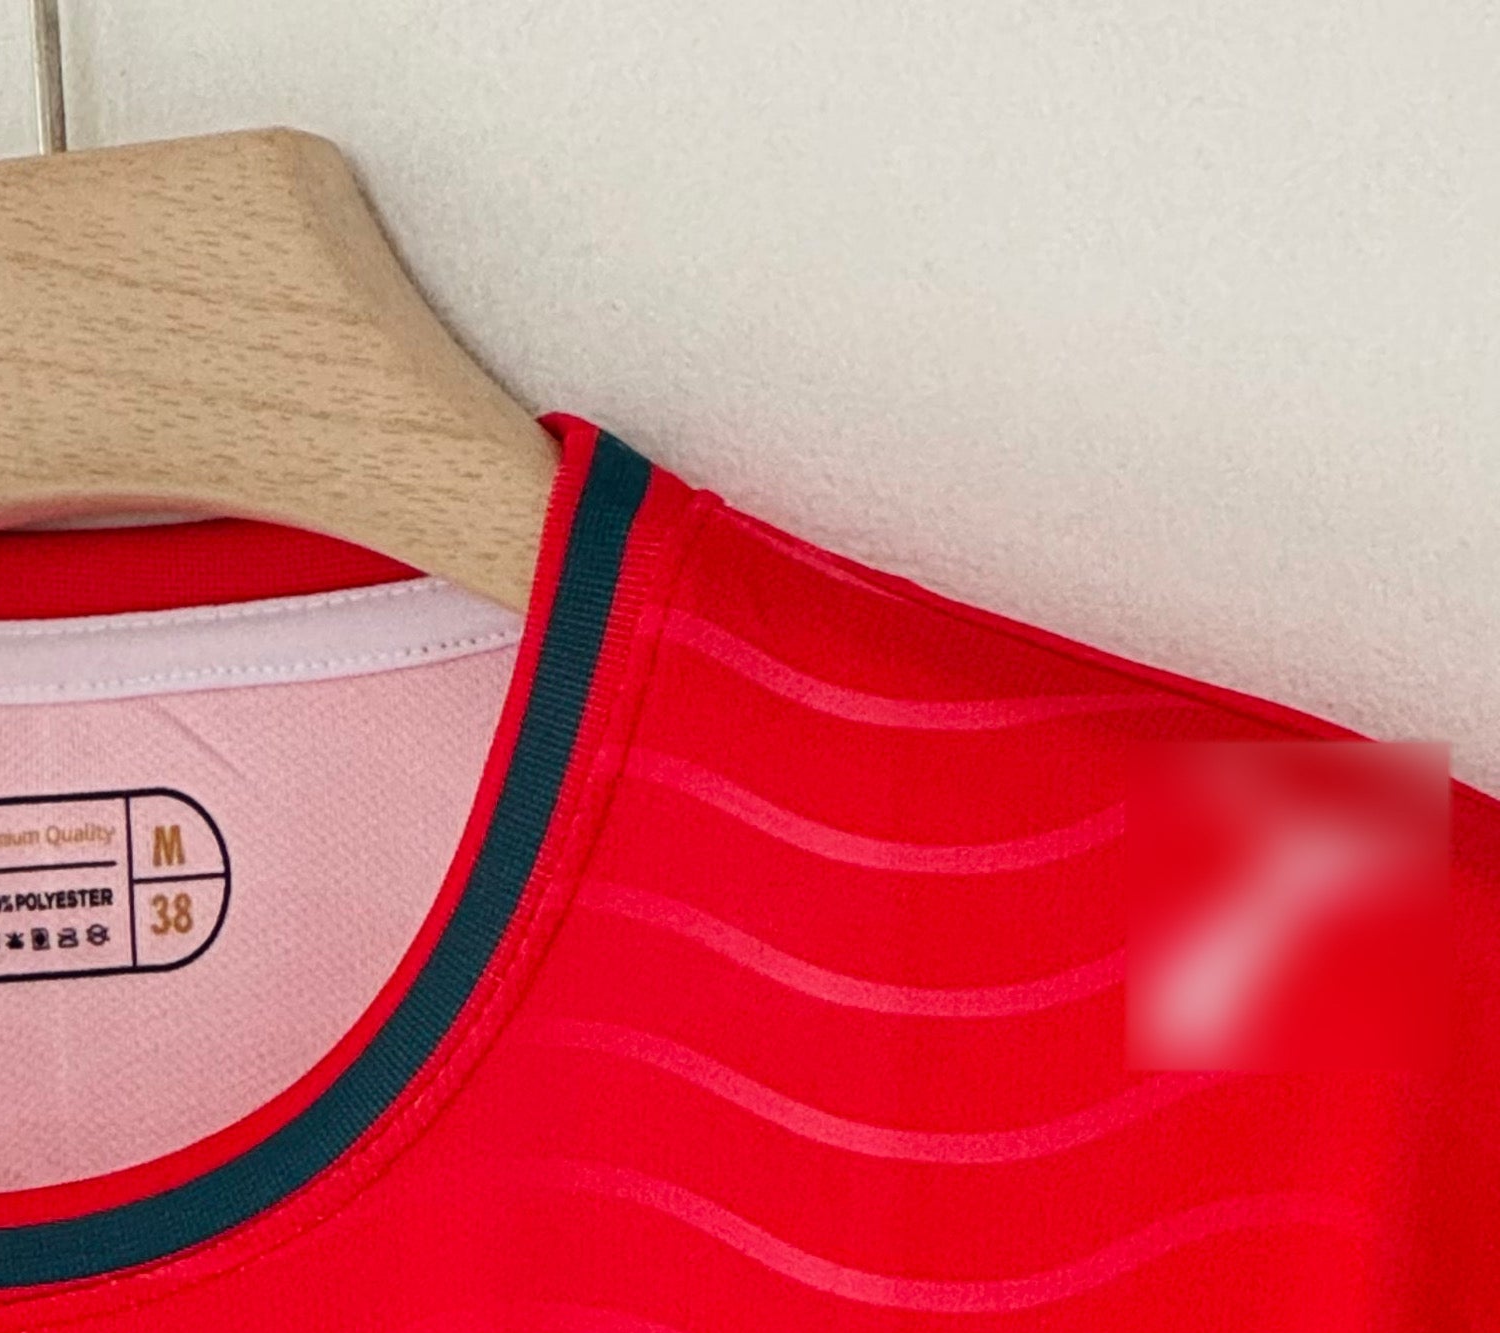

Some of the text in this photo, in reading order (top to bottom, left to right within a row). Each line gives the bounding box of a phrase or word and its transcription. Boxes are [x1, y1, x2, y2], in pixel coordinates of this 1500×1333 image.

[45, 822, 116, 846] Quality
[153, 824, 185, 867] M
[15, 887, 113, 912] POLYESTER
[150, 892, 193, 936] 38
